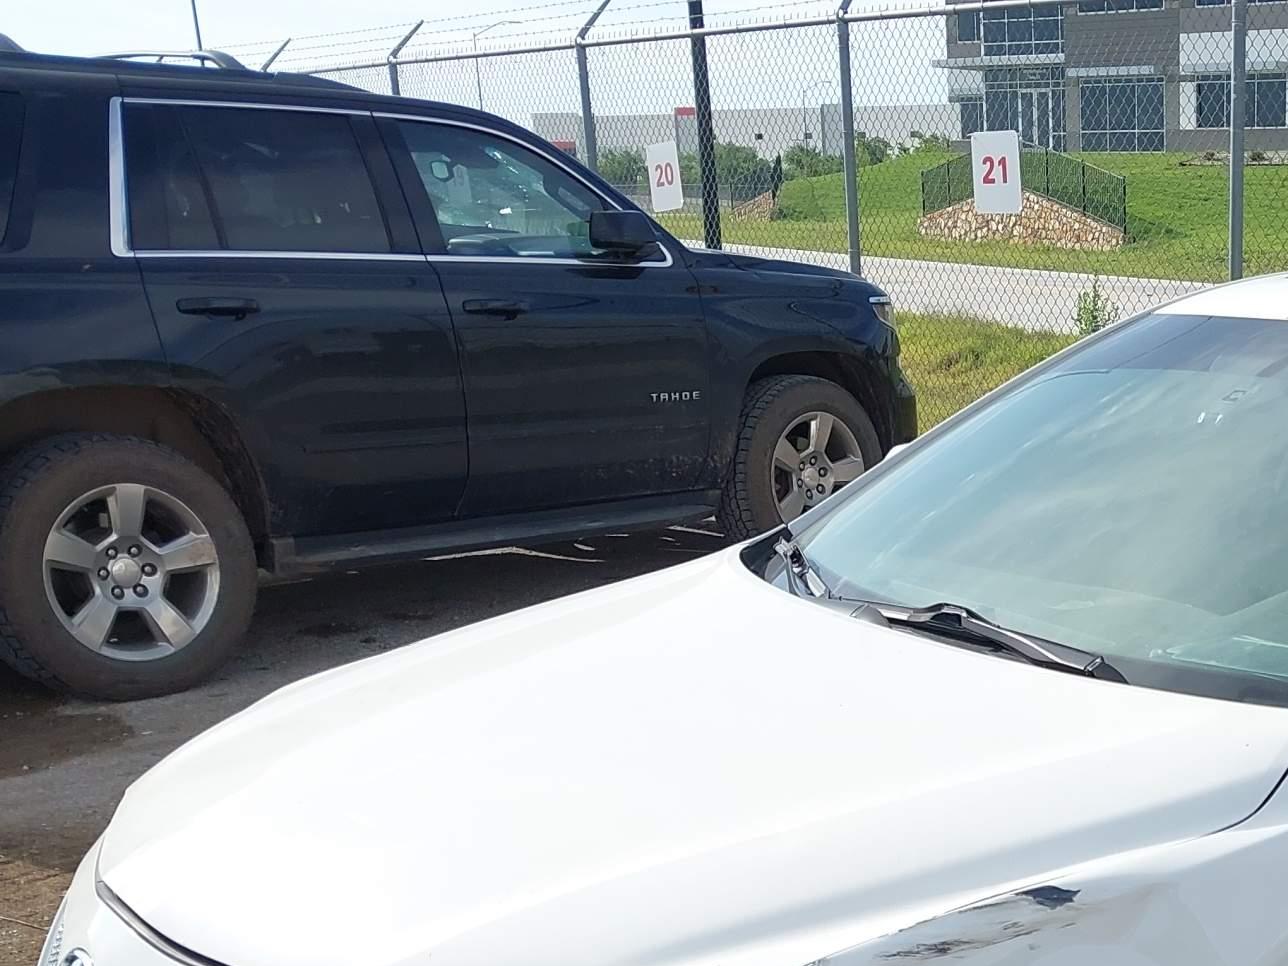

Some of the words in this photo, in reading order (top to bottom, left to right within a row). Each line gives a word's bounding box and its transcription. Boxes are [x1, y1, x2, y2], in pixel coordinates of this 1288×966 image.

[655, 161, 674, 188] 20
[982, 155, 1008, 185] 21
[650, 391, 702, 403] TAHOE
